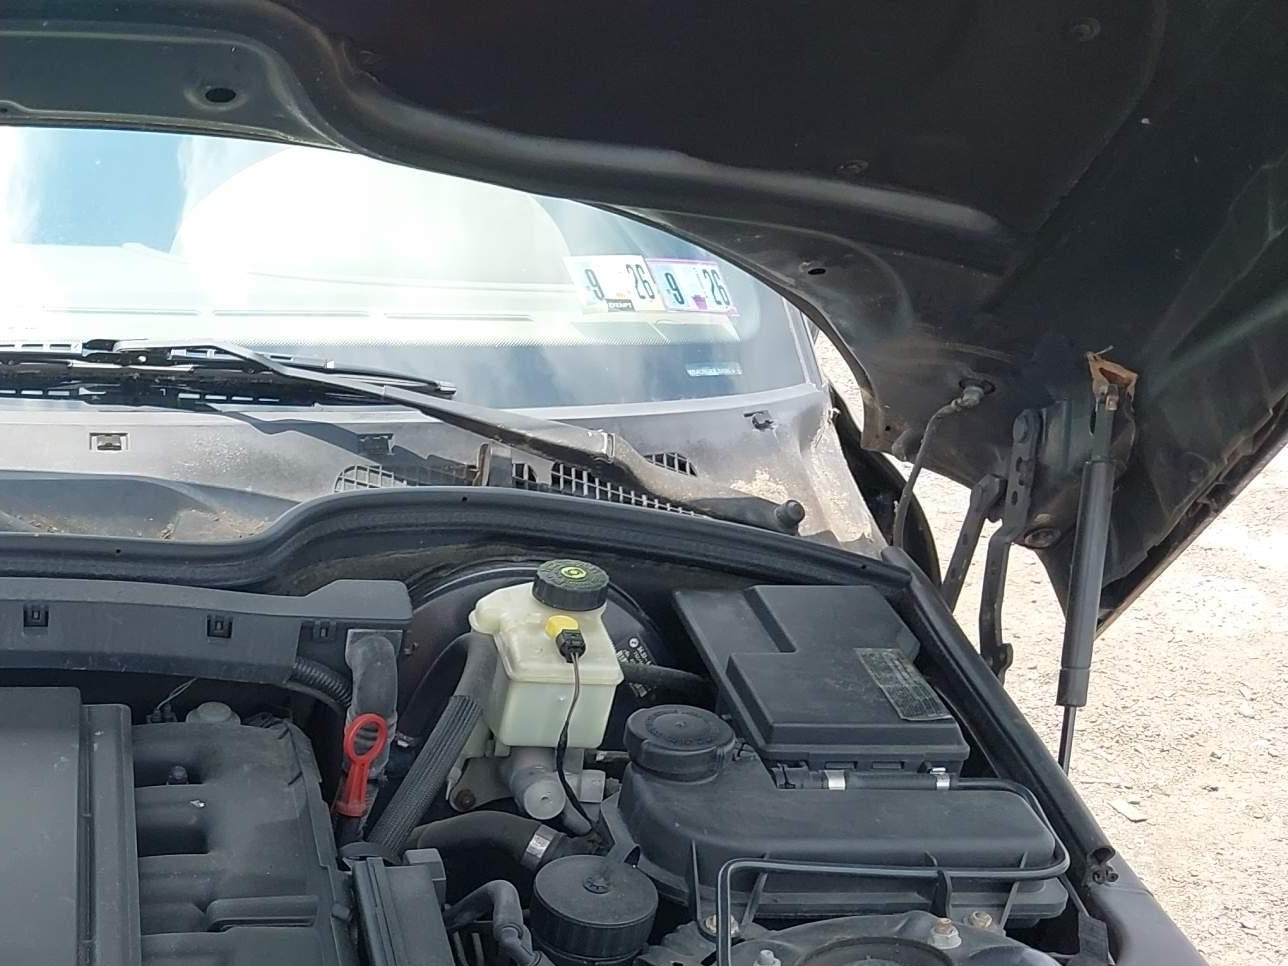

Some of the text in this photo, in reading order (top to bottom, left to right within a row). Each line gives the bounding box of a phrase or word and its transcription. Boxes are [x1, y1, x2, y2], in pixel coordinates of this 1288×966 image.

[584, 264, 656, 301] 9 26
[664, 268, 731, 306] 9 26
